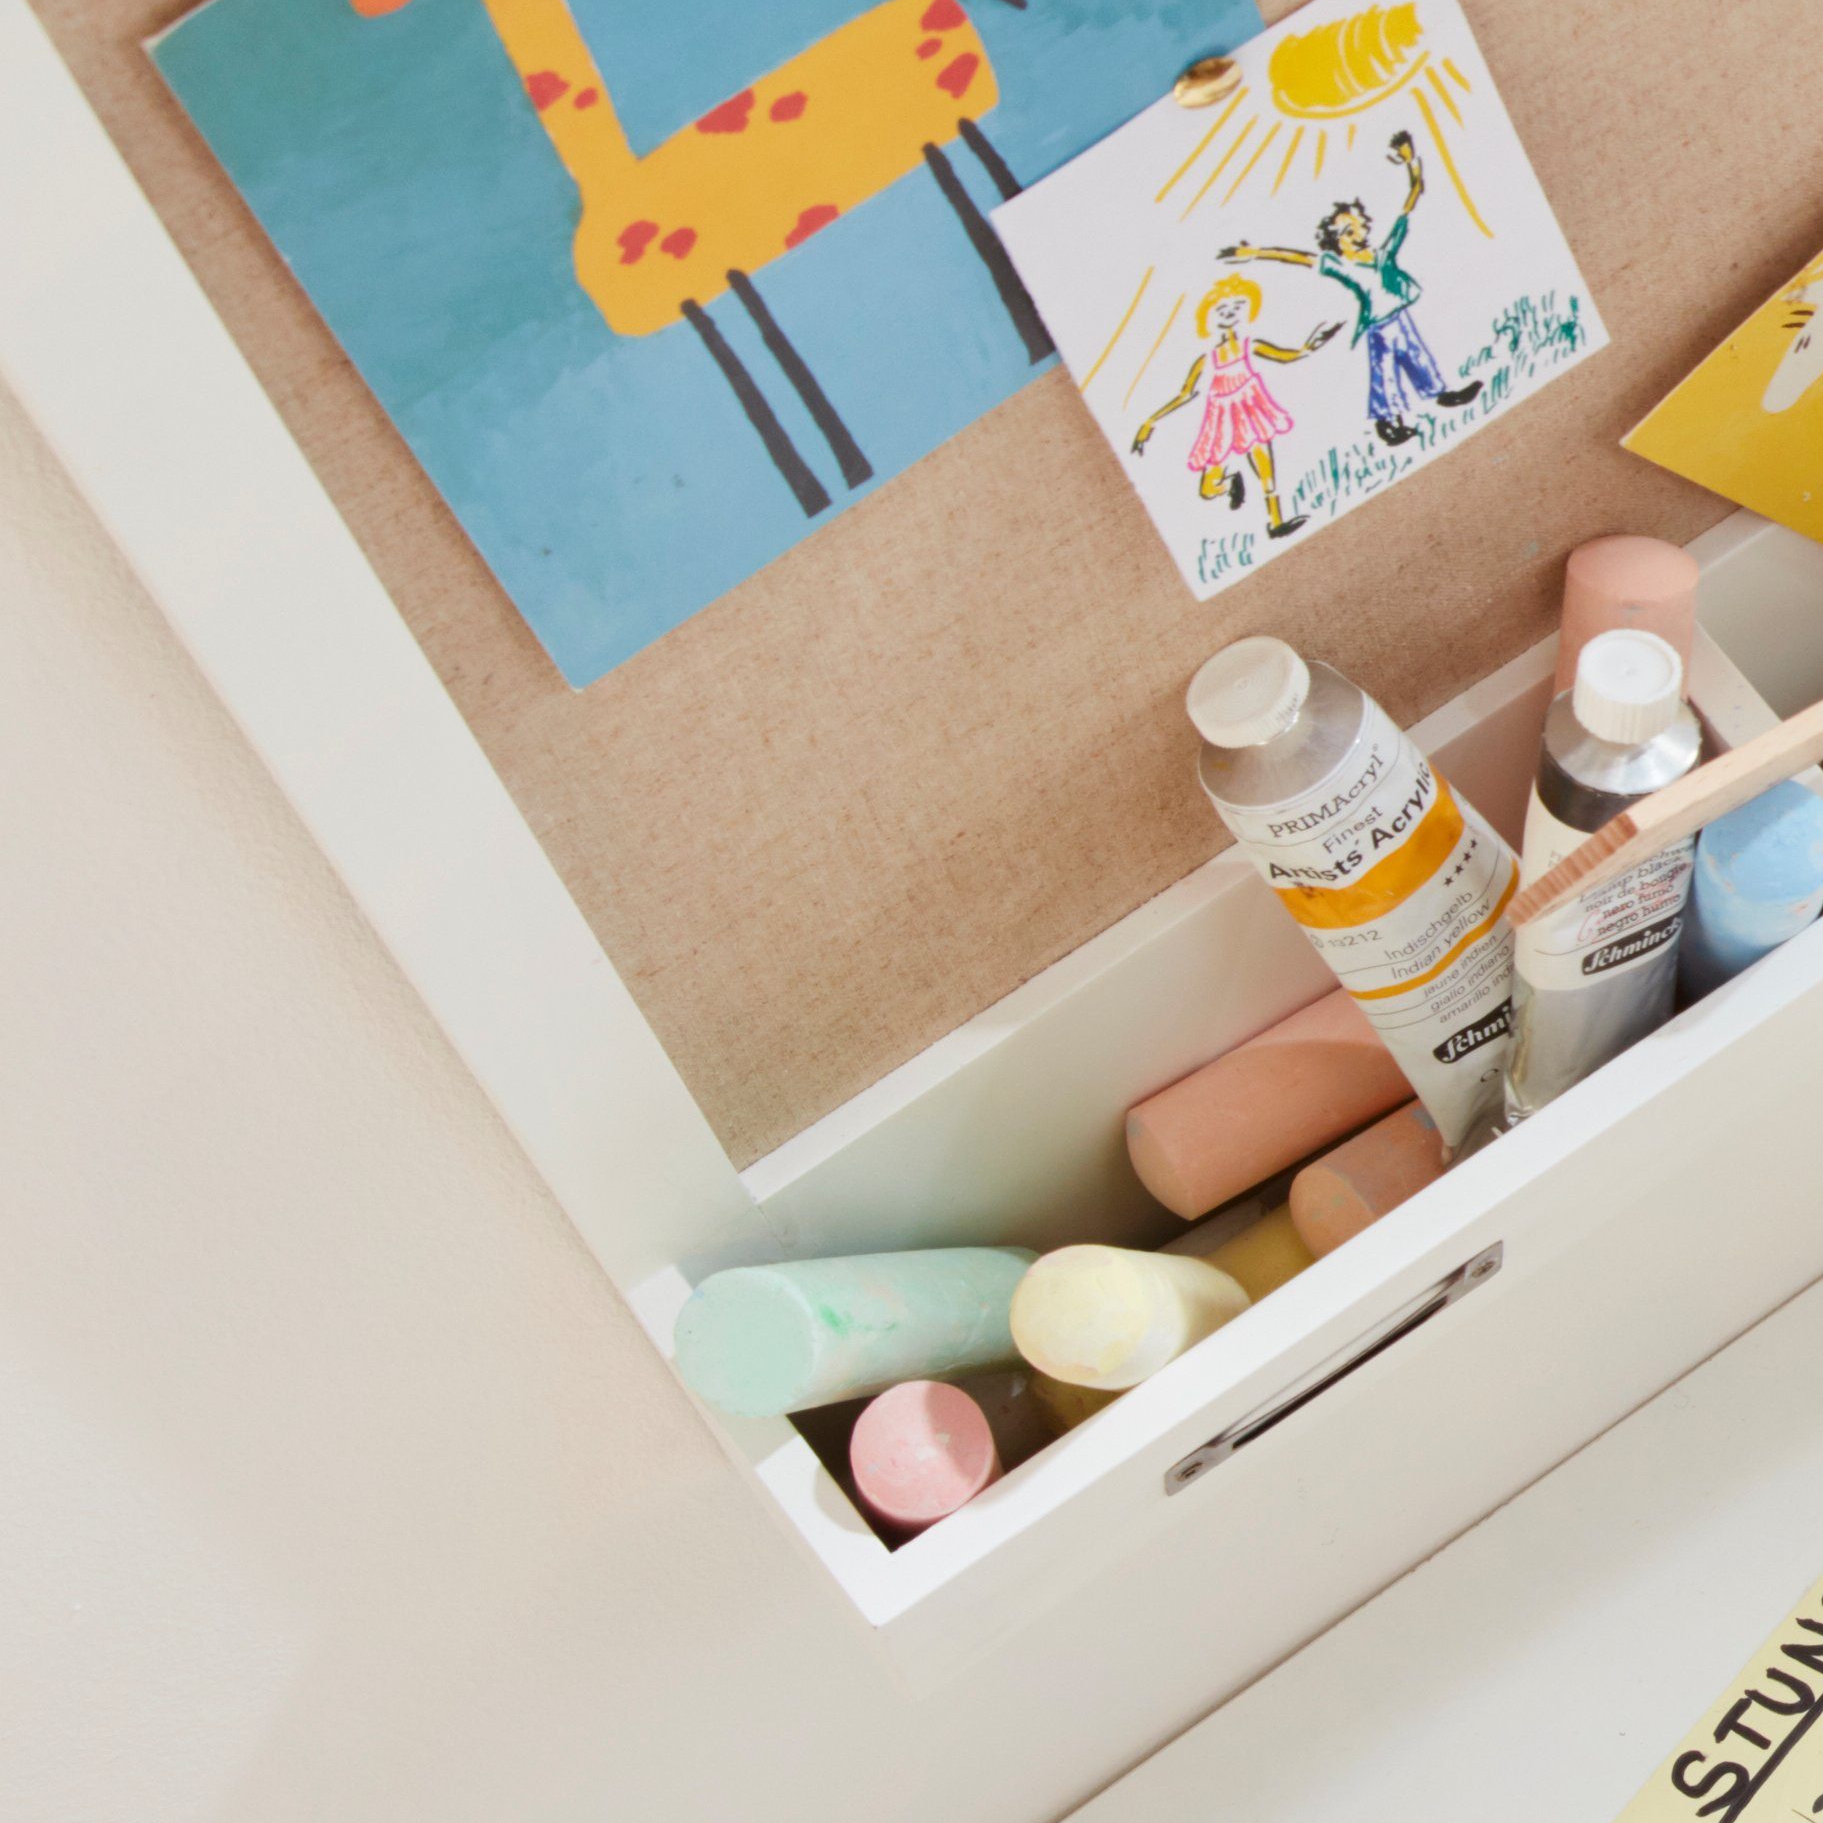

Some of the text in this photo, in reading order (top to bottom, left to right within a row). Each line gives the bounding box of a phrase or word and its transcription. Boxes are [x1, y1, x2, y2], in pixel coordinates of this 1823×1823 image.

[1322, 806, 1384, 855] Finest
[1585, 895, 1613, 913] noir
[1617, 886, 1637, 899] de
[1596, 892, 1682, 937] negro humo
[1602, 883, 1675, 920] nero fumo
[1383, 890, 1473, 962] Indischgelb
[1390, 943, 1443, 981] Indian
[1446, 899, 1491, 949] yellow
[1422, 966, 1460, 999] jaune
[1459, 934, 1498, 970] indien
[1430, 979, 1469, 1013] giallo
[1468, 943, 1511, 980] indiano
[1438, 985, 1491, 1025] amarillo
